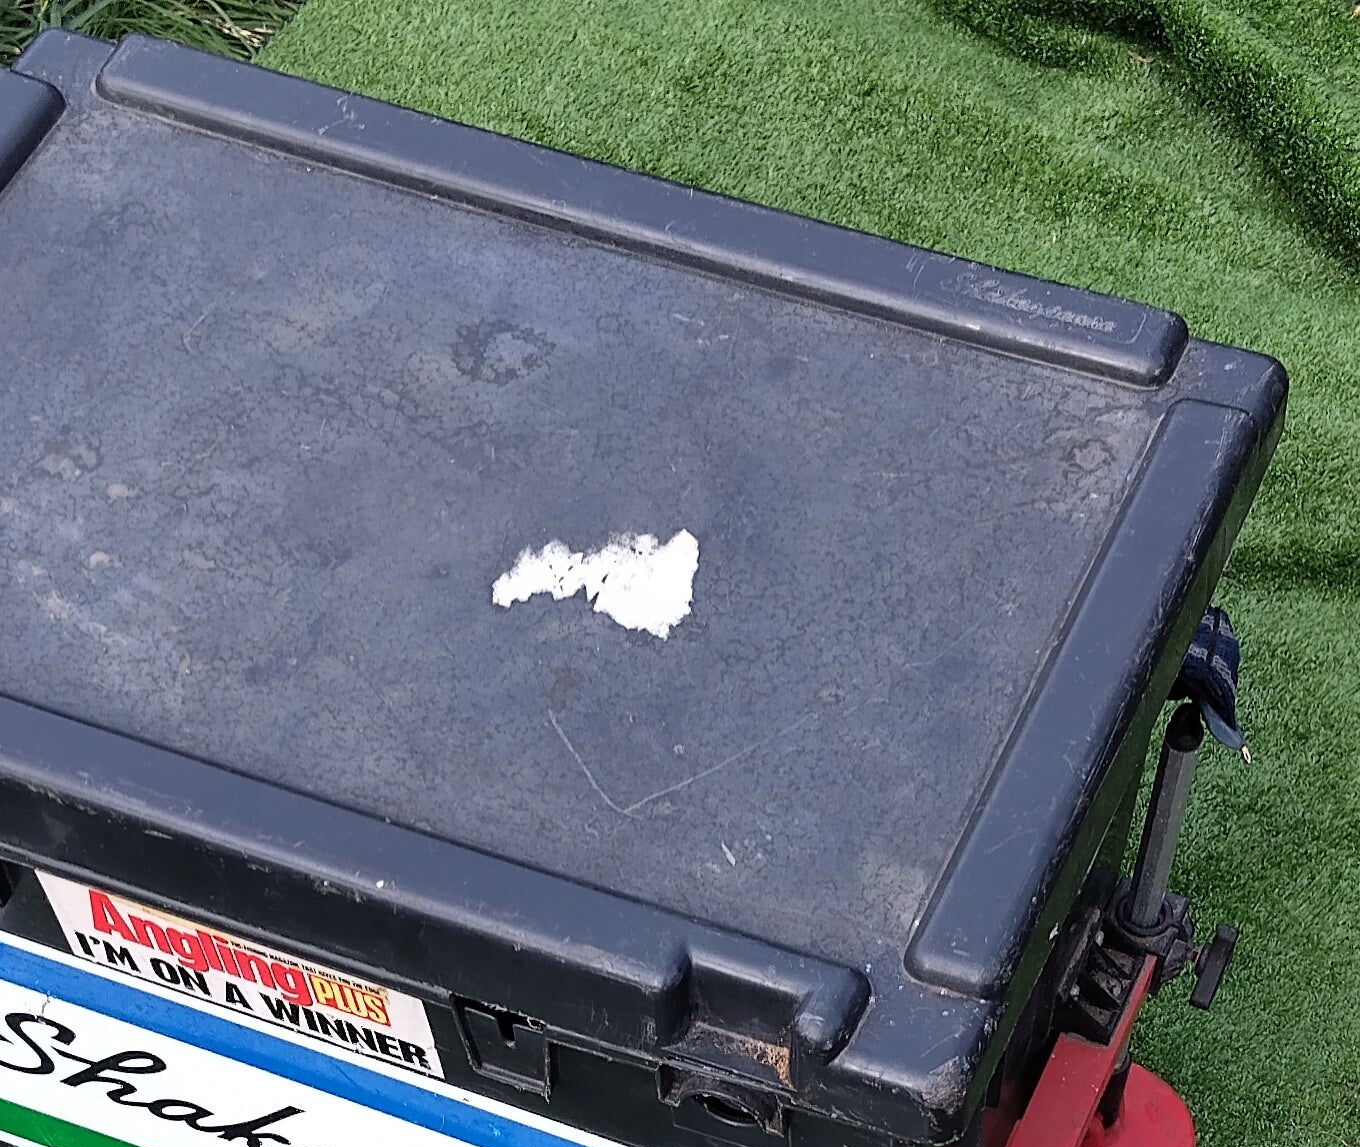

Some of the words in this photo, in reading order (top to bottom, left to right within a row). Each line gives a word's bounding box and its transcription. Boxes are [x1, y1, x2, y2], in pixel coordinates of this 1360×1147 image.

[74, 930, 141, 973] I'M
[149, 957, 212, 997] ON
[226, 981, 253, 1011] A
[258, 991, 432, 1070] WINNER
[89, 889, 313, 1006] Angling
[311, 975, 389, 1025] PLUS
